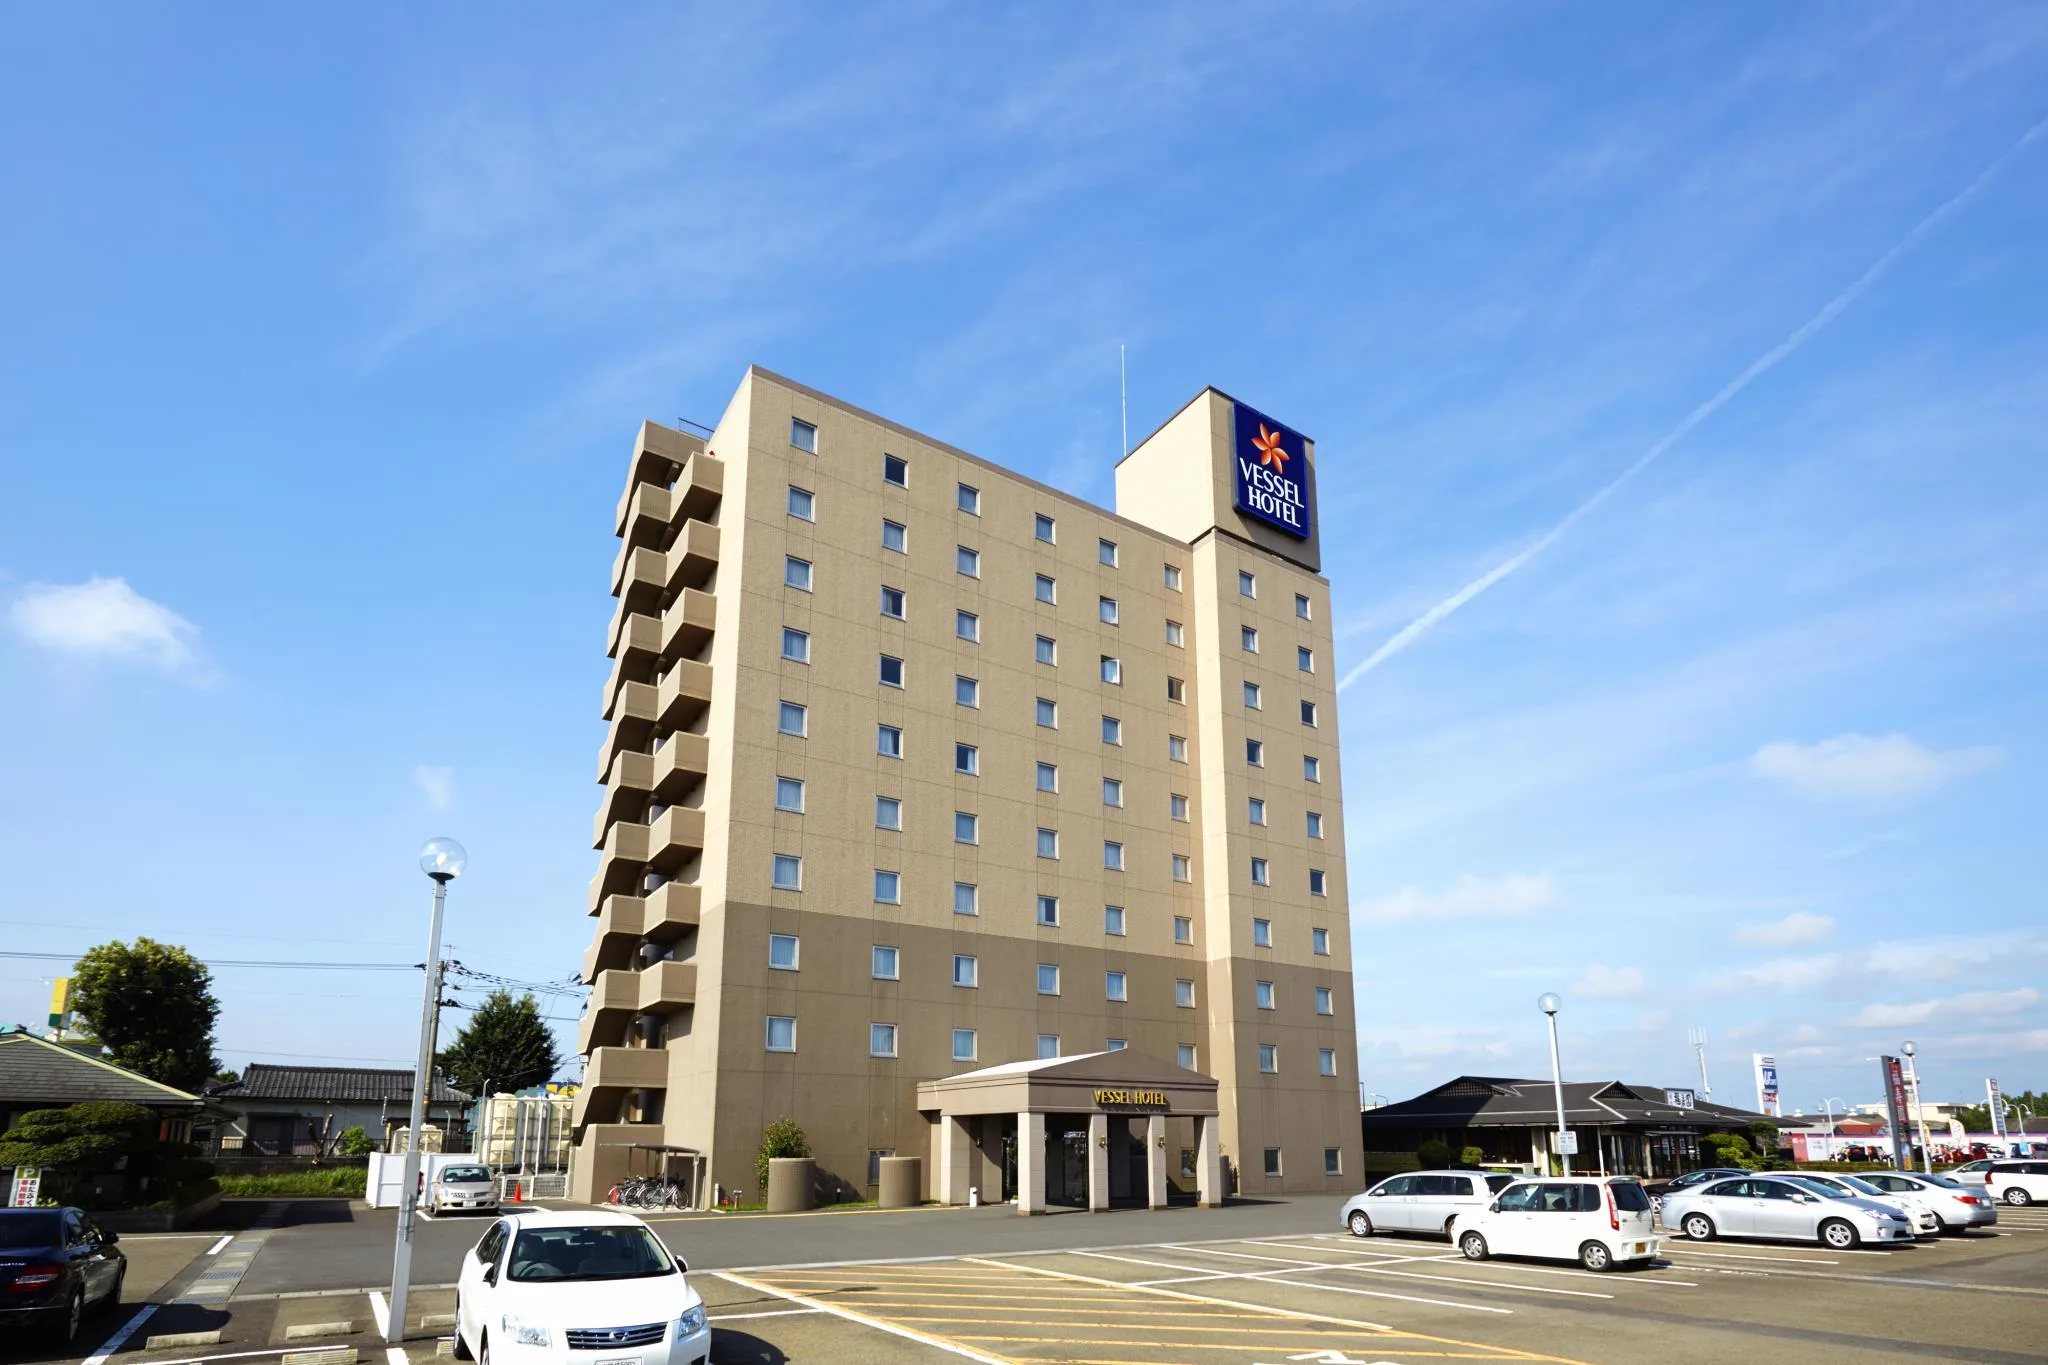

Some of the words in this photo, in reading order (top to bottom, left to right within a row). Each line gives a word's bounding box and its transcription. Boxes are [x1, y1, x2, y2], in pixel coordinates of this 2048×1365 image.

[1239, 457, 1305, 508] VESSEL
[1248, 485, 1301, 528] HOTEL
[1093, 1088, 1132, 1104] VESSEL
[1134, 1089, 1167, 1105] HOTEL
[24, 1168, 35, 1178] P
